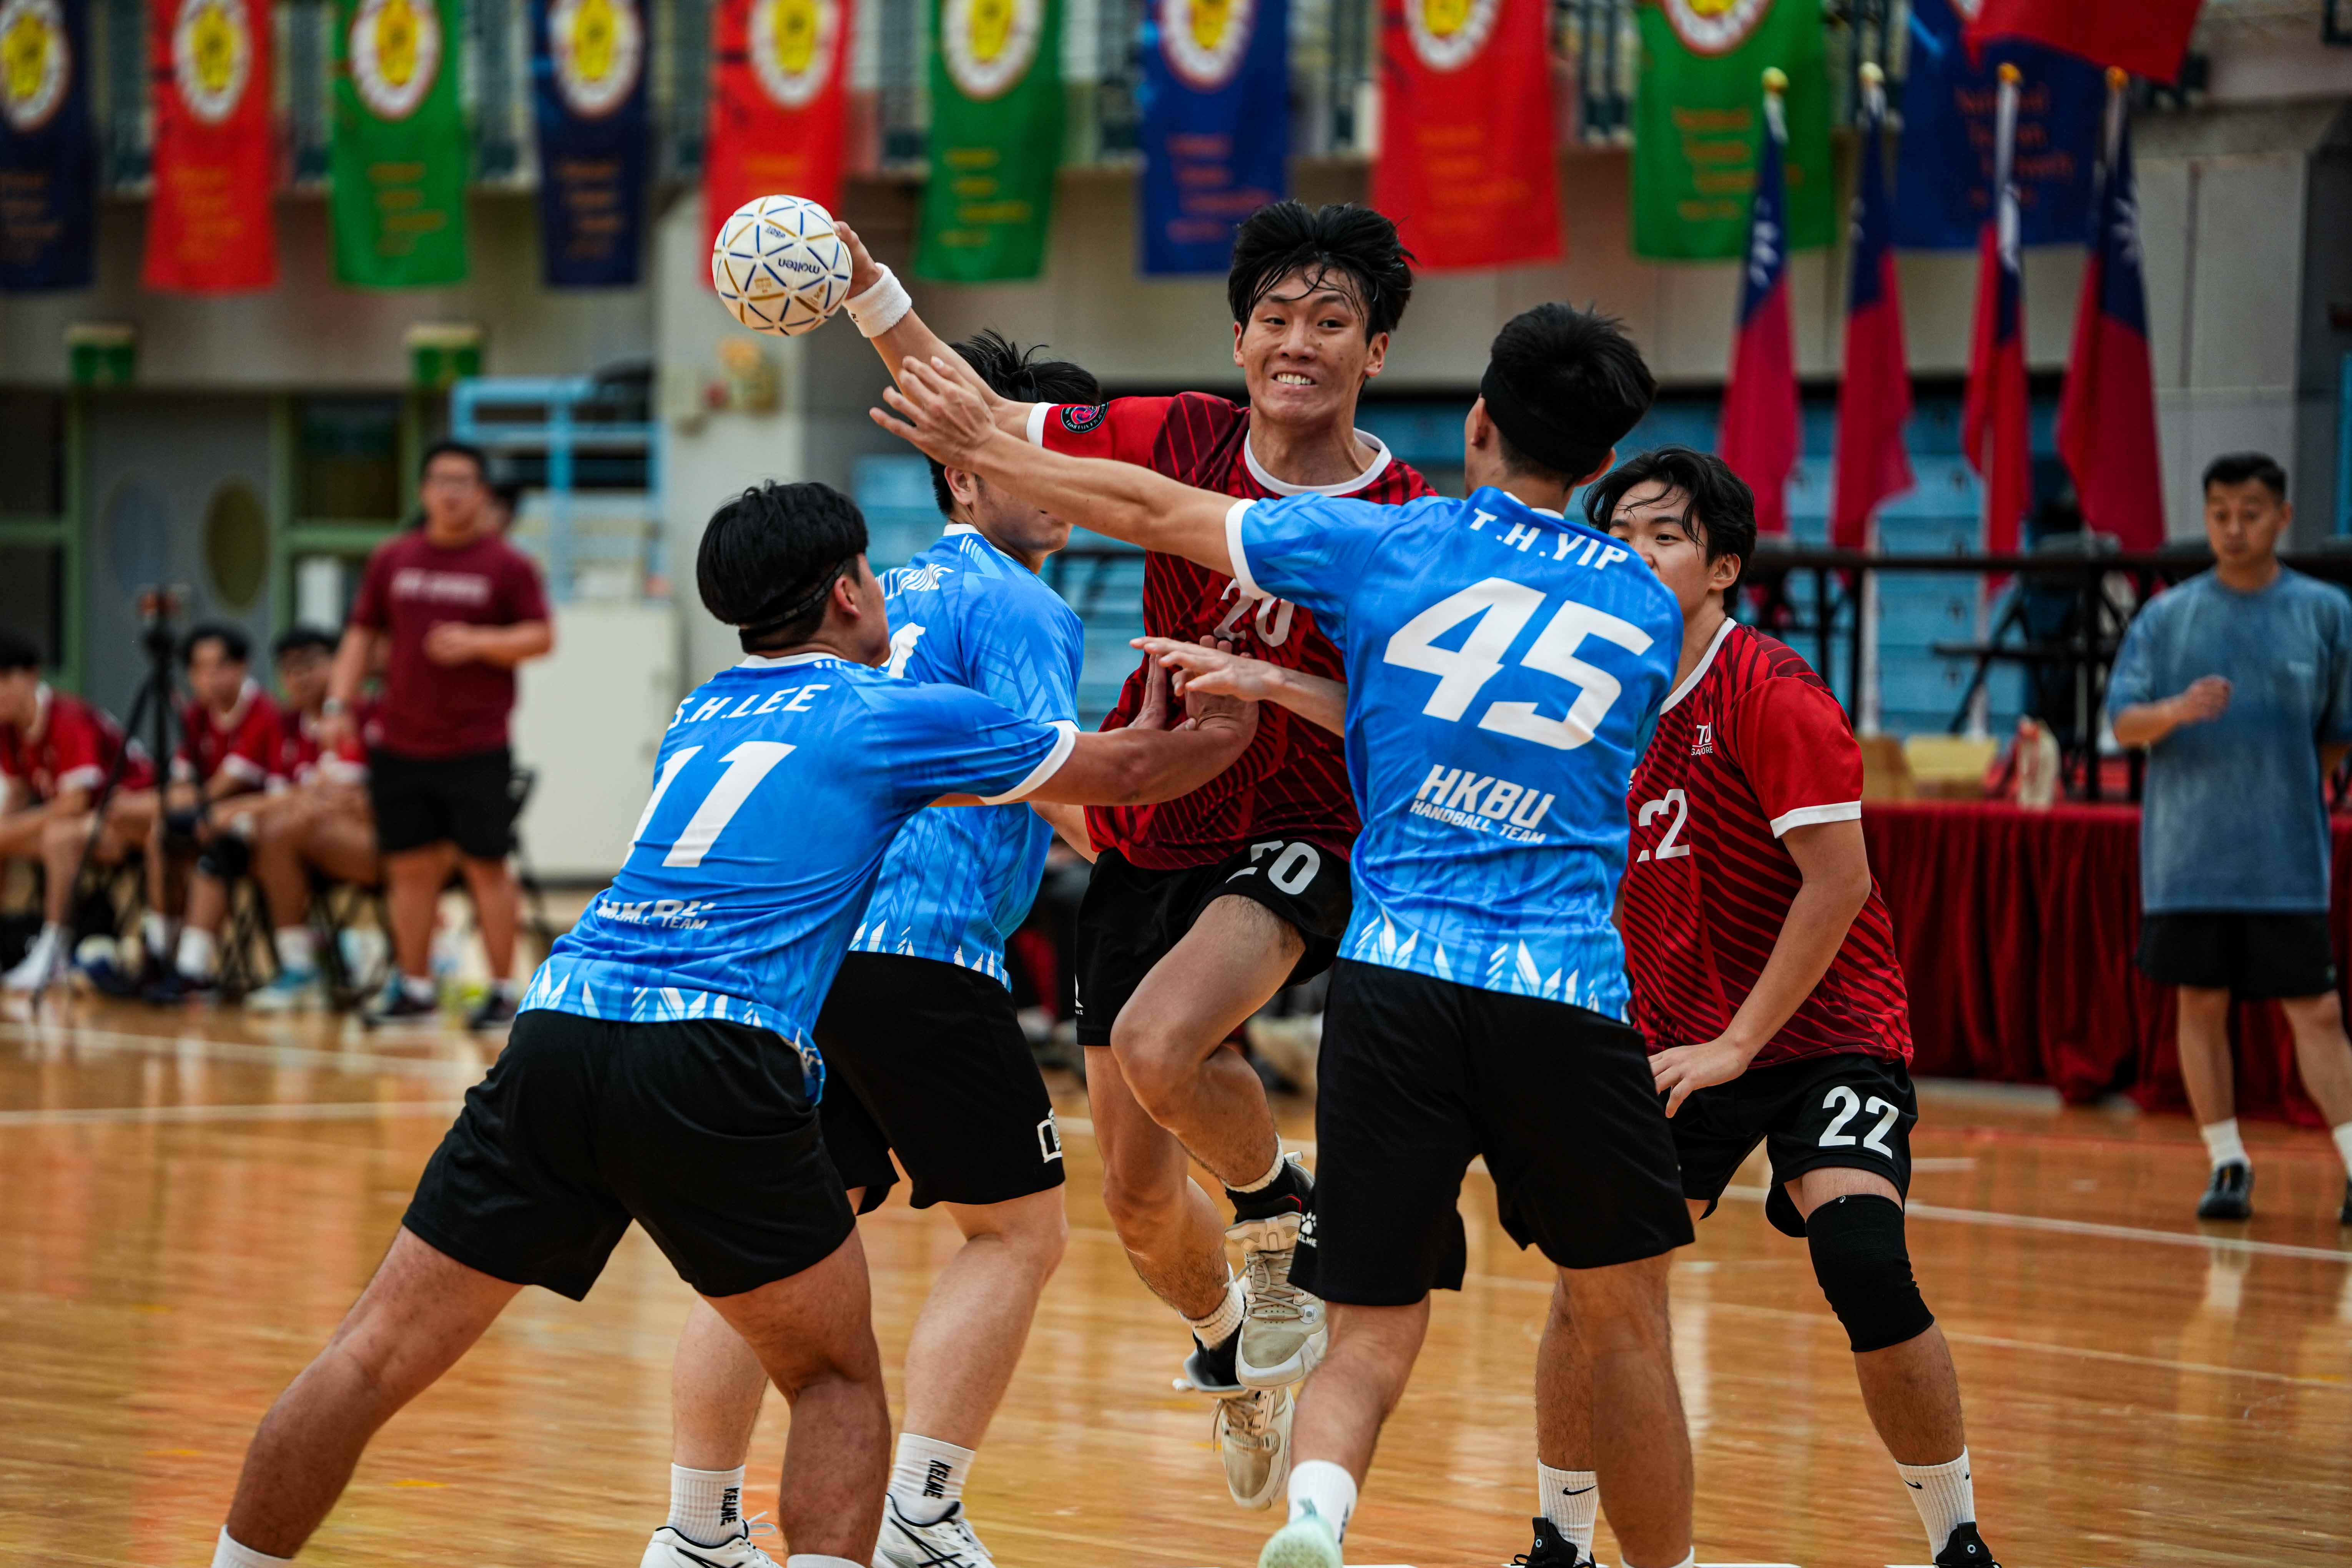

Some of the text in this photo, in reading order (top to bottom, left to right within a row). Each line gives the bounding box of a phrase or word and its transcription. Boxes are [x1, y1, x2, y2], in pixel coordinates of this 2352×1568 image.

[778, 258, 820, 274] molten
[1469, 508, 1629, 570] T.H.YIP
[1213, 578, 1295, 647] 20
[1383, 577, 1654, 750] 45
[667, 684, 831, 730] S.H.LEE
[622, 741, 798, 868] 11
[1409, 800, 1546, 844] HANDBALL TEAM
[1416, 764, 1556, 829] HKBU
[1637, 789, 1690, 863] 22
[1225, 840, 1320, 895] 20
[661, 915, 708, 930] TEAM
[1818, 1086, 1899, 1159] 22
[720, 1487, 740, 1526] KELME
[922, 1459, 953, 1499] KELME
